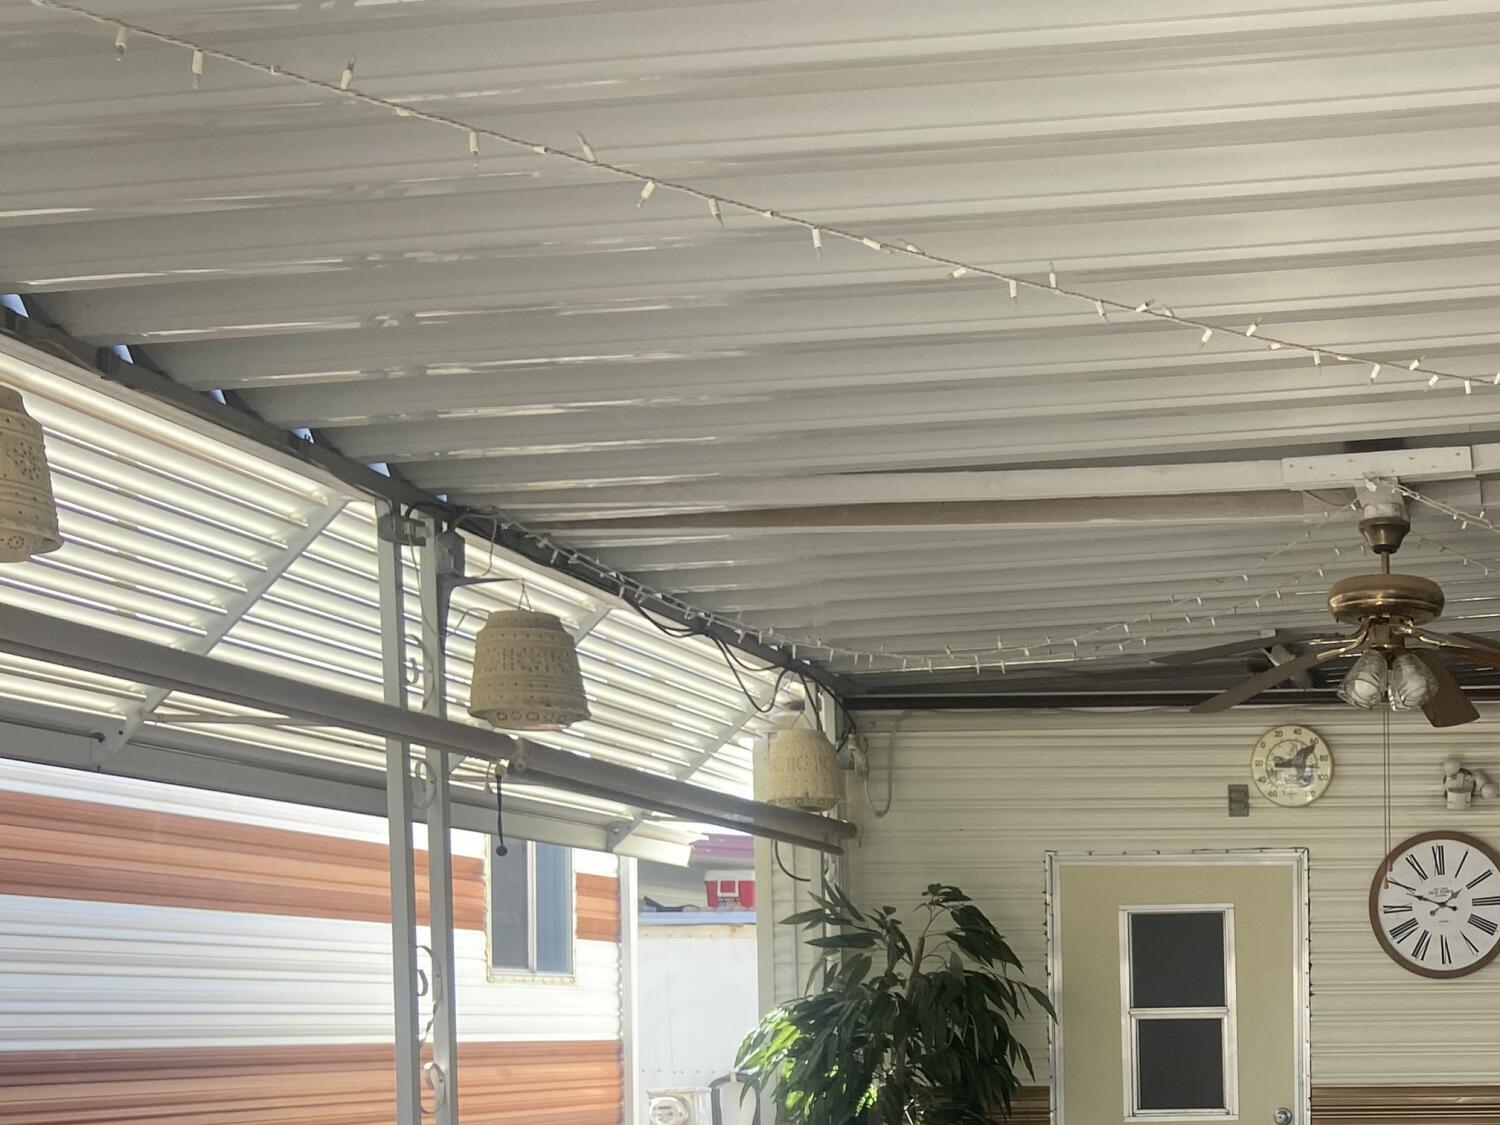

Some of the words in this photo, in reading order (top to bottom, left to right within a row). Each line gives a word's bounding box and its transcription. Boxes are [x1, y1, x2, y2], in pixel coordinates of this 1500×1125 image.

[1274, 730, 1283, 738] 20
[1293, 727, 1303, 735] 40
[1260, 741, 1266, 749] 0
[1304, 790, 1316, 798] 10
